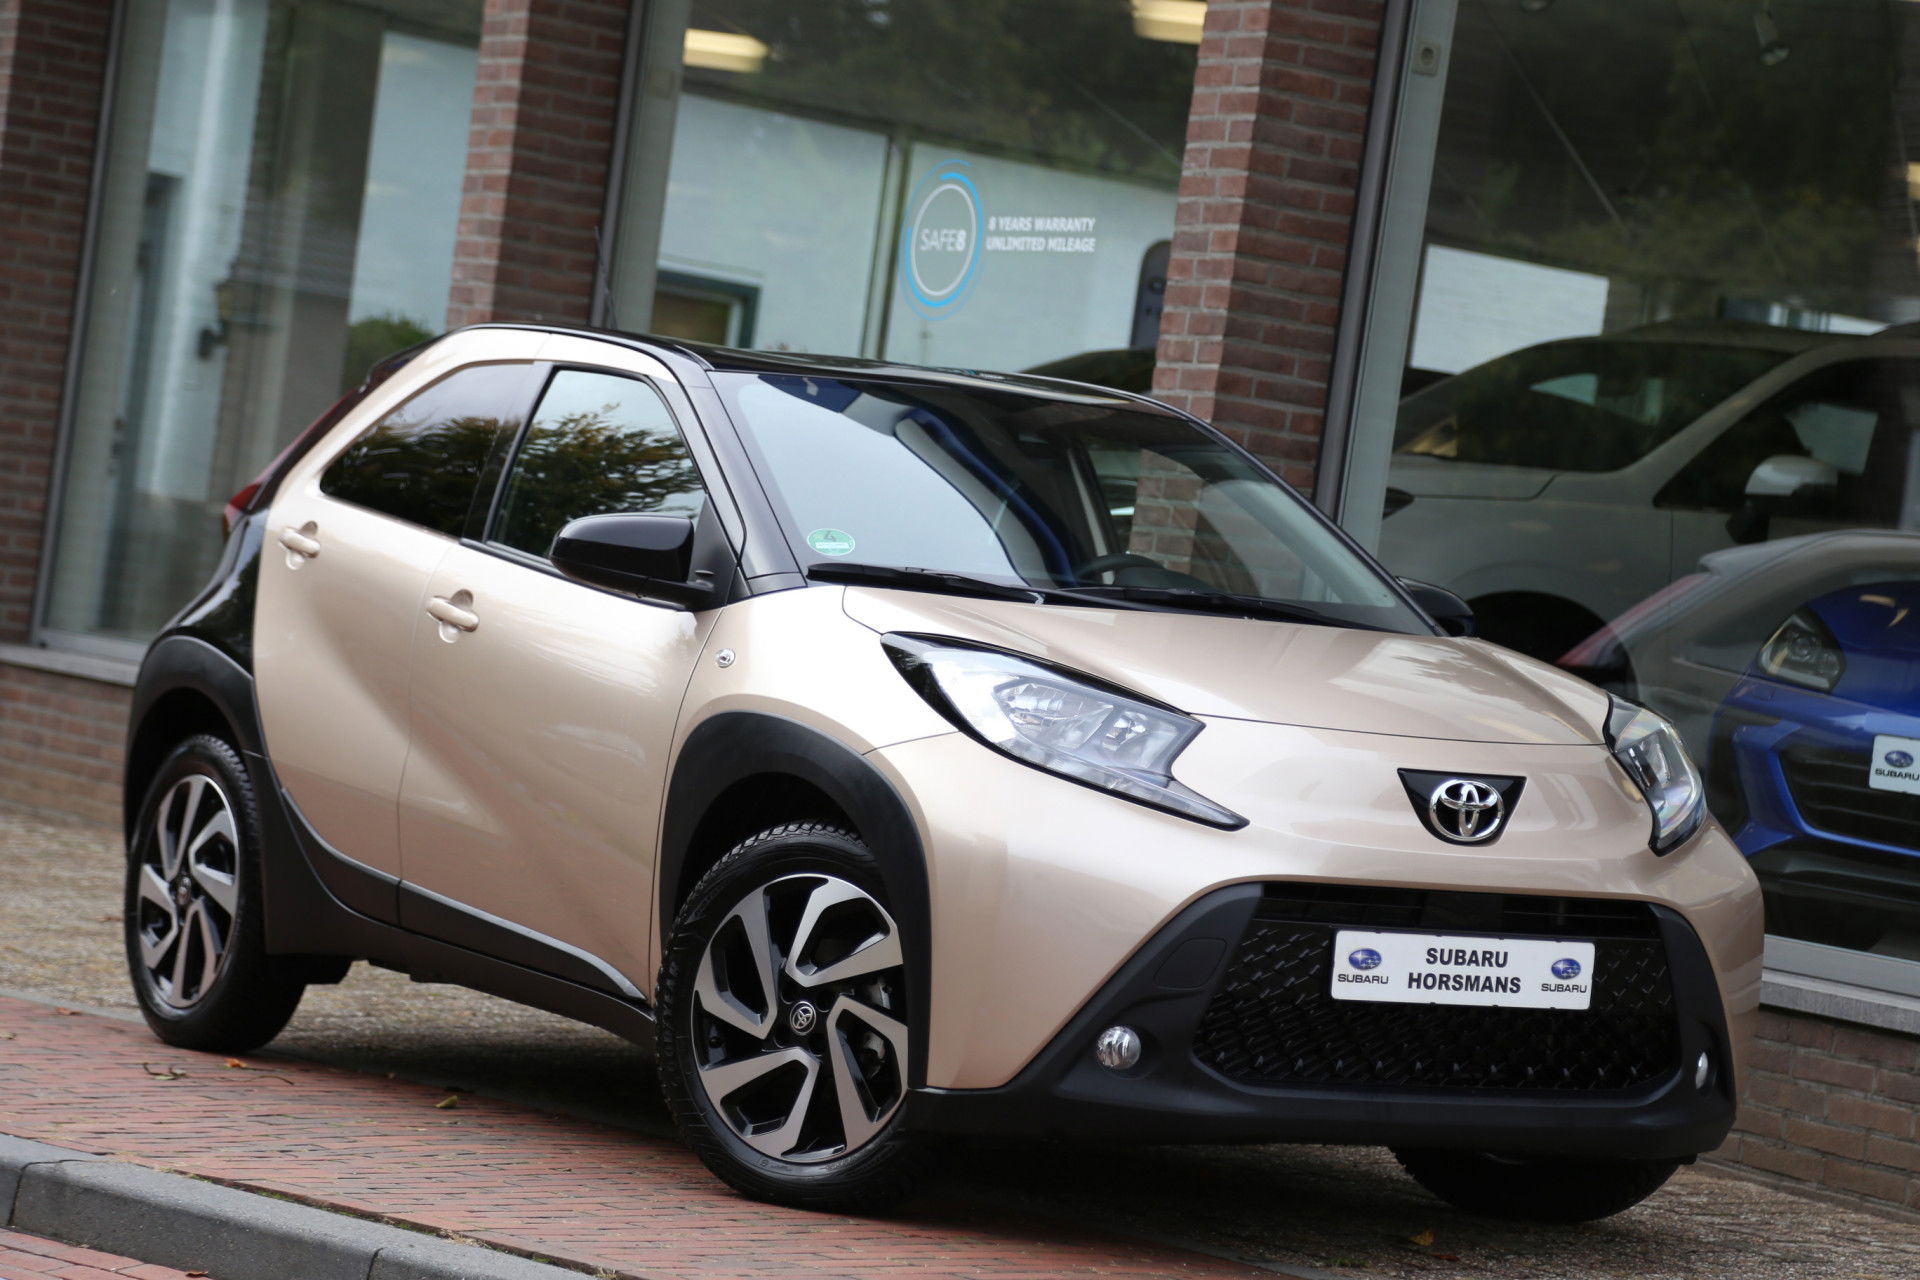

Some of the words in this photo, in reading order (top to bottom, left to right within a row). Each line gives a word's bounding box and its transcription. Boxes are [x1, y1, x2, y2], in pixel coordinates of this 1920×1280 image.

[988, 216, 996, 231] 8
[999, 216, 1032, 232] YEARS
[1034, 216, 1096, 232] WARRANTY
[986, 236, 1046, 251] UNLIMITED
[1047, 237, 1096, 252] MILEAGE
[1875, 768, 1920, 781] SUBARU
[1425, 947, 1508, 968] SUBARU
[1337, 973, 1389, 985] SUBARU
[1407, 971, 1521, 994] HORSMANS
[1541, 983, 1588, 994] SUBARU
